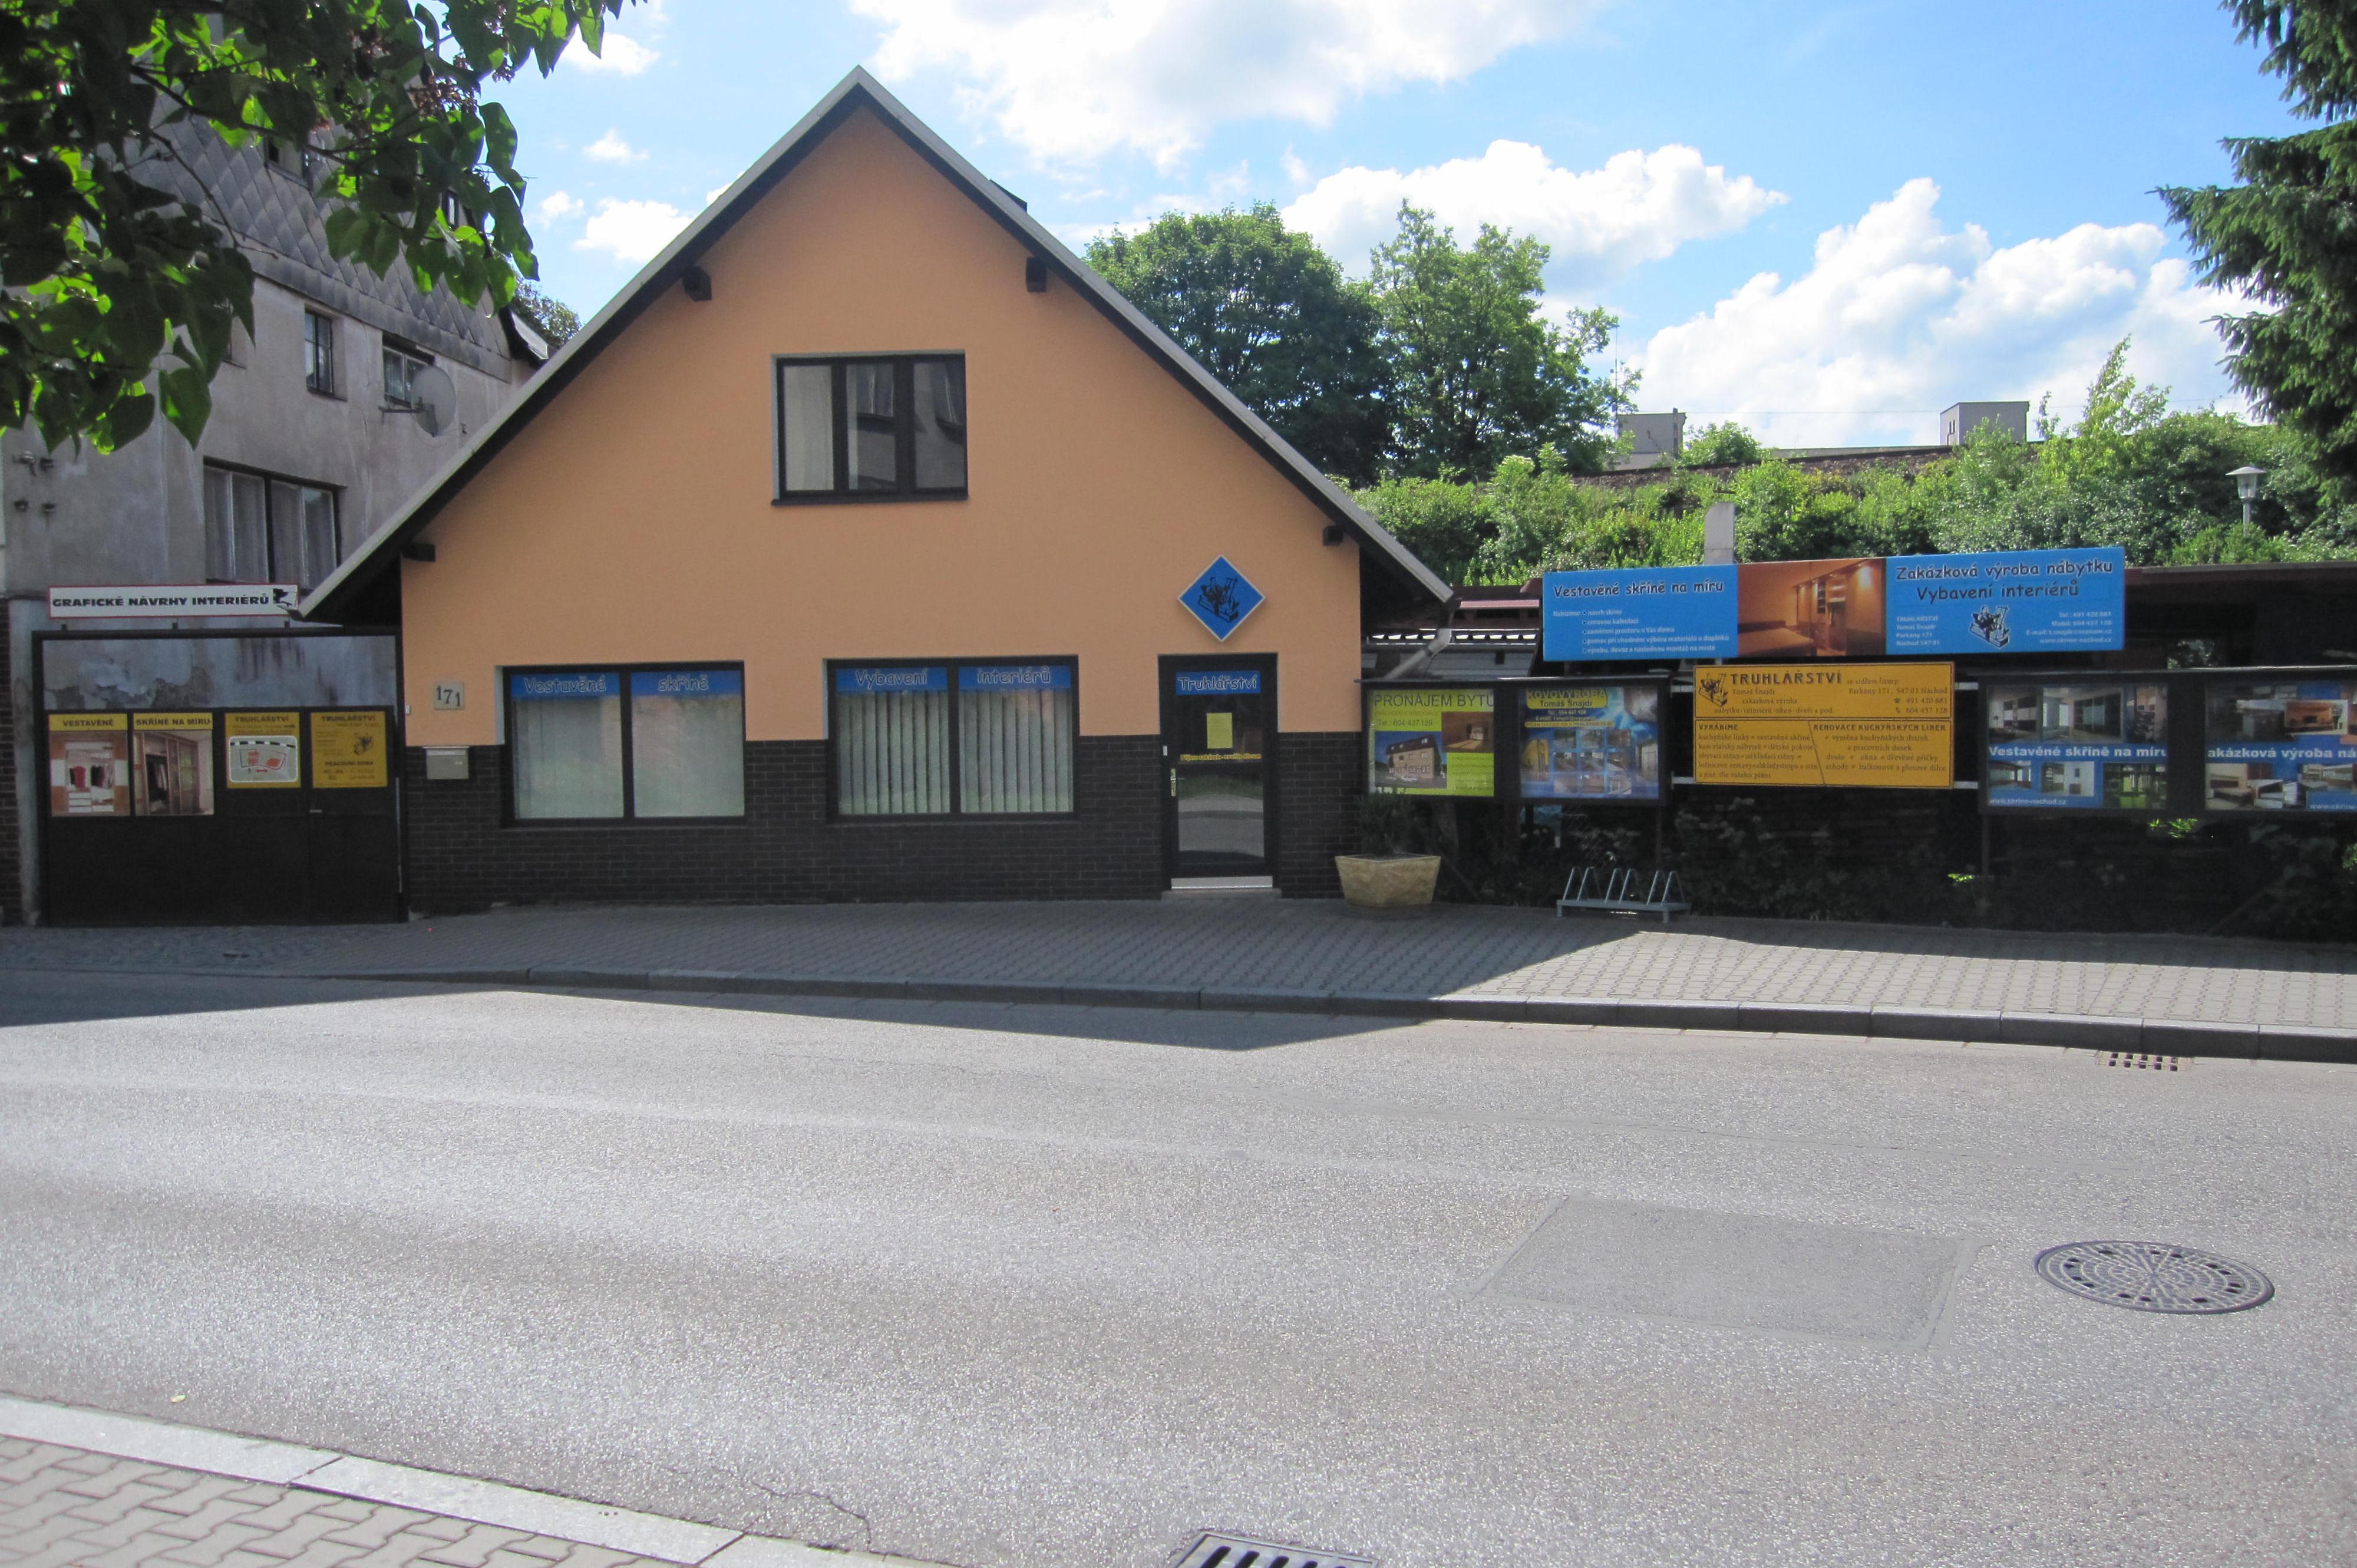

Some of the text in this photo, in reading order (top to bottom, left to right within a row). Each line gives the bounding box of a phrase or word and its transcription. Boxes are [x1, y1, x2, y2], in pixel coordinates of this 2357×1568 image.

[1896, 559, 2113, 580] Zakázková výroba nábytku
[1554, 579, 1724, 598] Vestavěné skříně na míru
[1916, 579, 2080, 605] Vybavení interiérů
[52, 593, 269, 607] GRAFICKÉ NÁVRHY INTERIÉRŮ
[523, 673, 709, 694] Vestavěné skříně
[855, 666, 1051, 690] Vybavení interiérů
[1178, 674, 1258, 691] Truhlářství
[1731, 670, 1842, 685] TRUHLÁŘSTVÍ
[435, 685, 462, 708] 171
[1374, 693, 1453, 707] PRONÁJEM
[1989, 745, 2061, 757] Vestavěné
[2065, 745, 2110, 757] skříně
[2114, 748, 2131, 757] na
[2282, 747, 2332, 760] výroba
